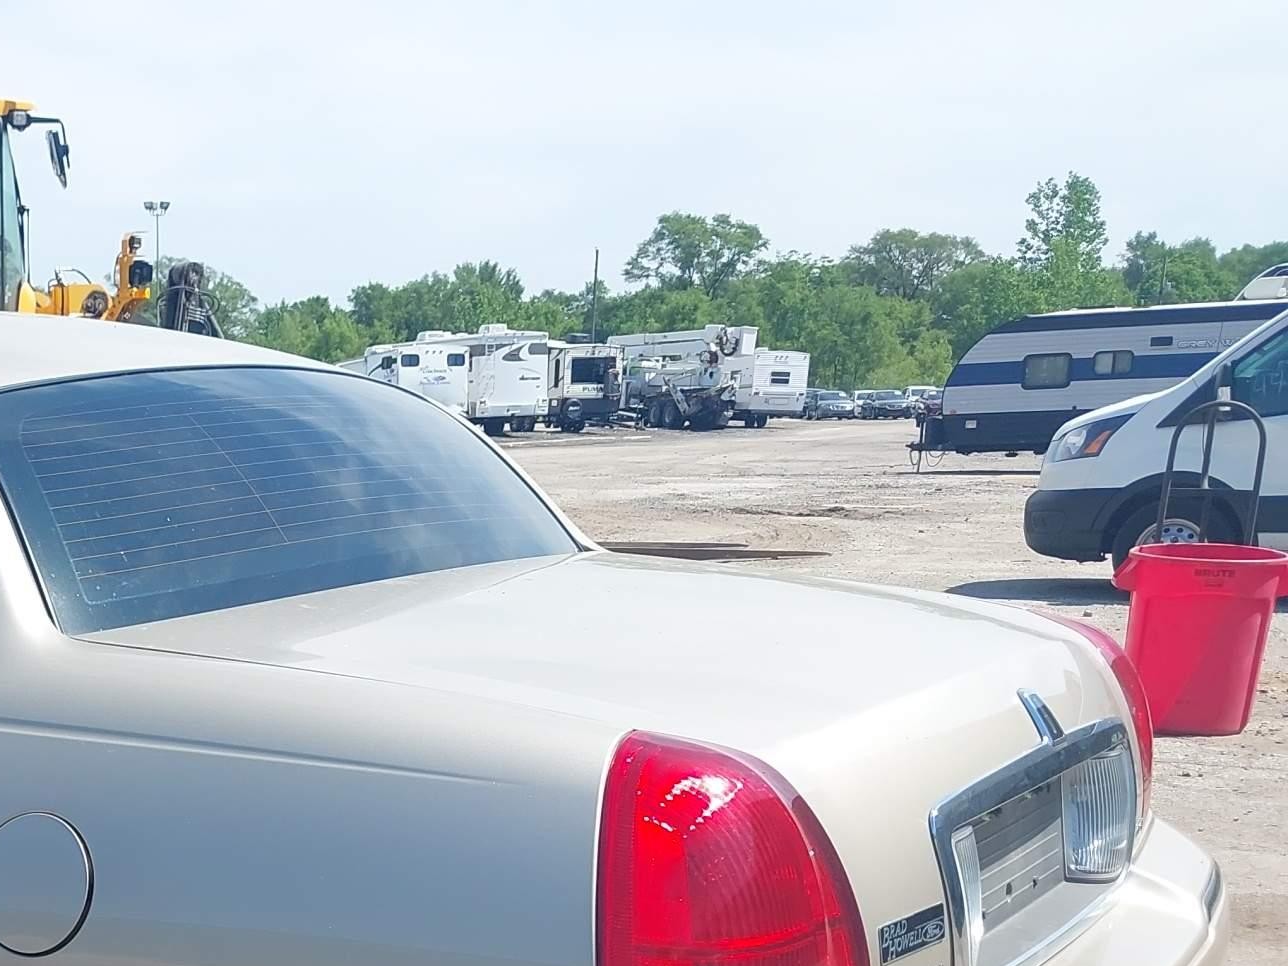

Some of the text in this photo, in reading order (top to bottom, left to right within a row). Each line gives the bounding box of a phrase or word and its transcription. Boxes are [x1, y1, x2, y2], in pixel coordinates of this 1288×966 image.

[1177, 339, 1217, 348] GREY
[882, 919, 909, 948] BRAD
[887, 924, 941, 962] HOWELL Ford
